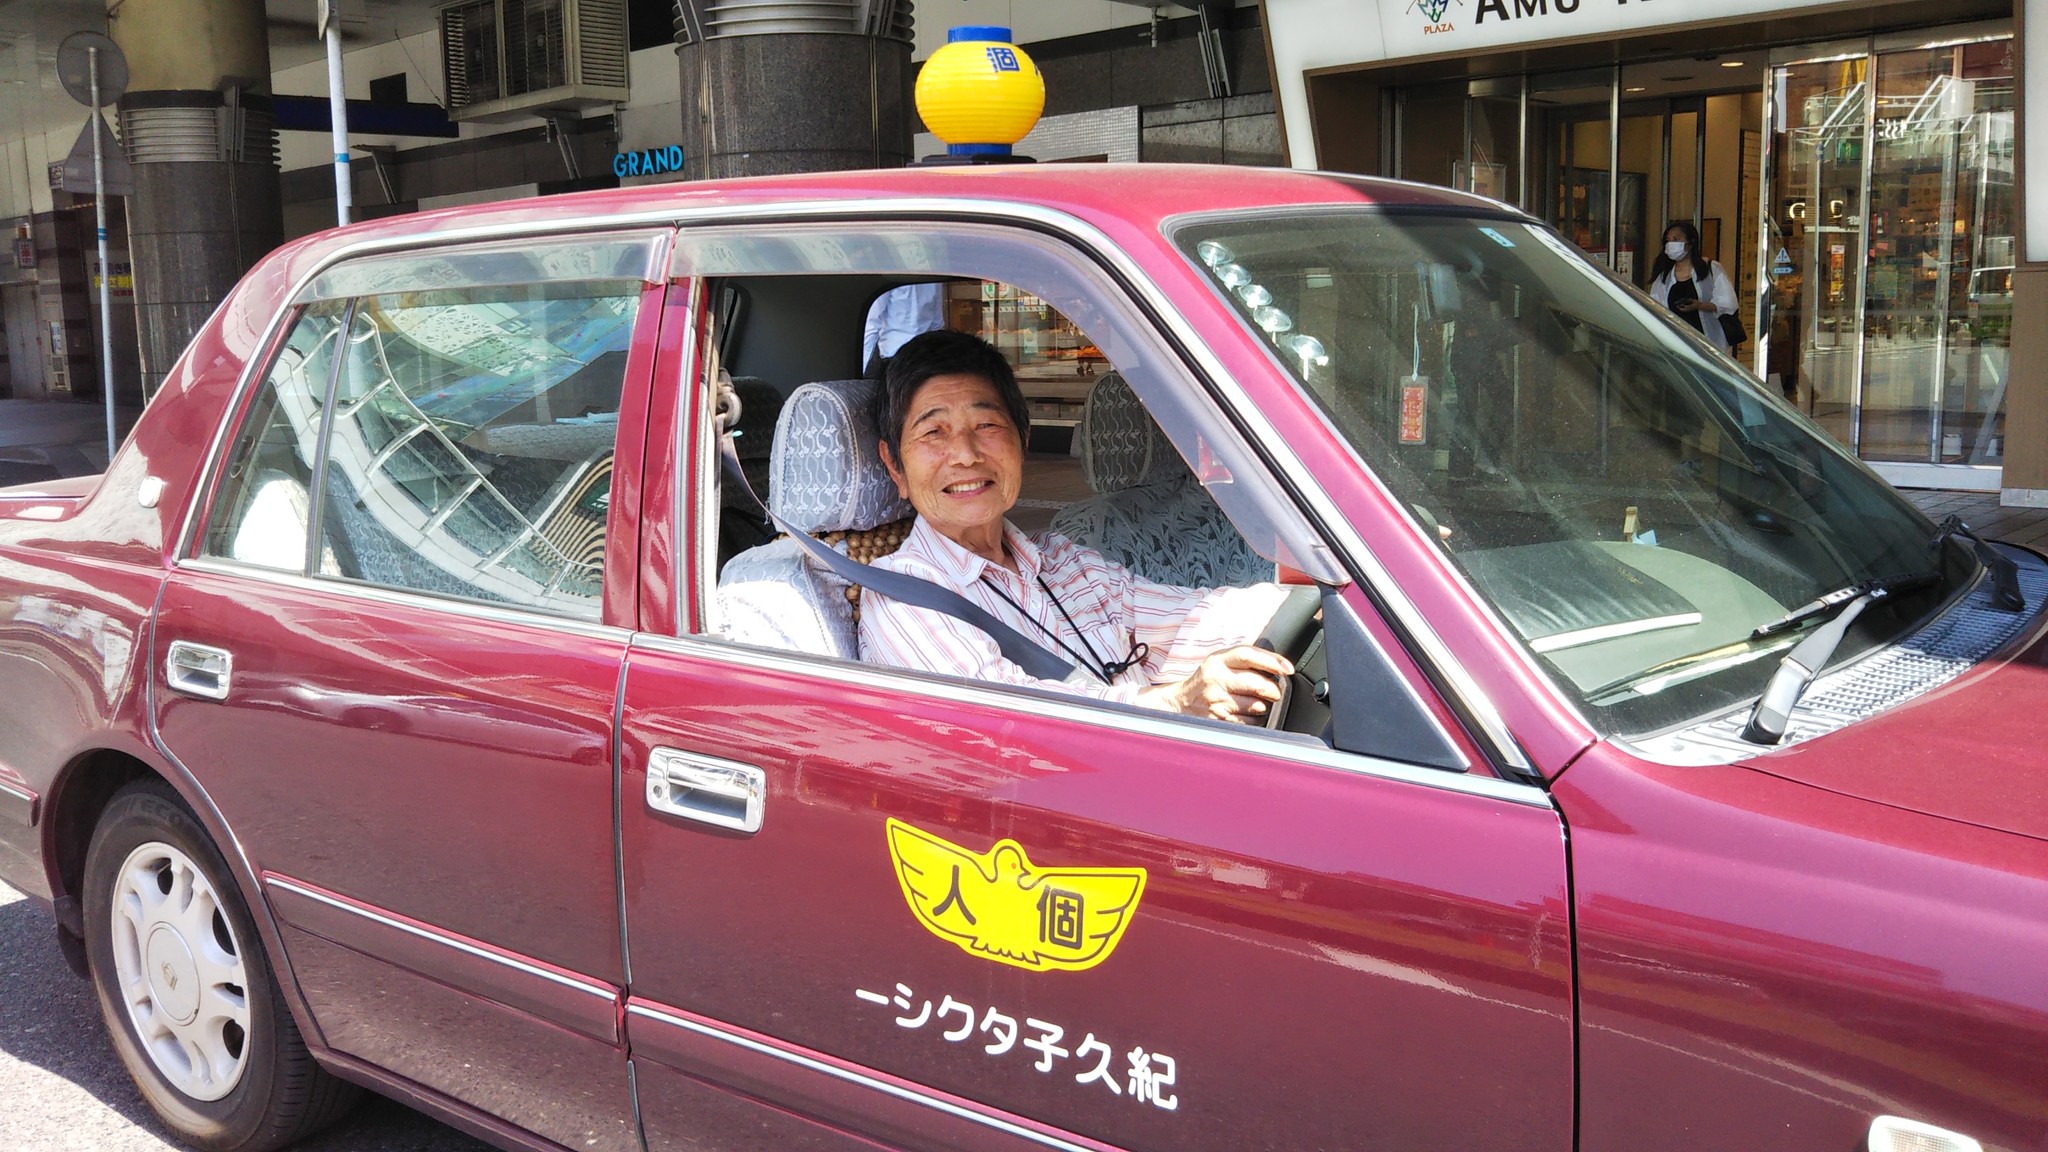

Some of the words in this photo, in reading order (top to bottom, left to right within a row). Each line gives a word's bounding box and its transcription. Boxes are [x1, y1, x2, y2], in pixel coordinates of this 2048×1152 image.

[1423, 22, 1455, 35] PLAZA
[613, 145, 684, 178] GRAND
[932, 864, 977, 925] 人
[1036, 884, 1084, 950] 個
